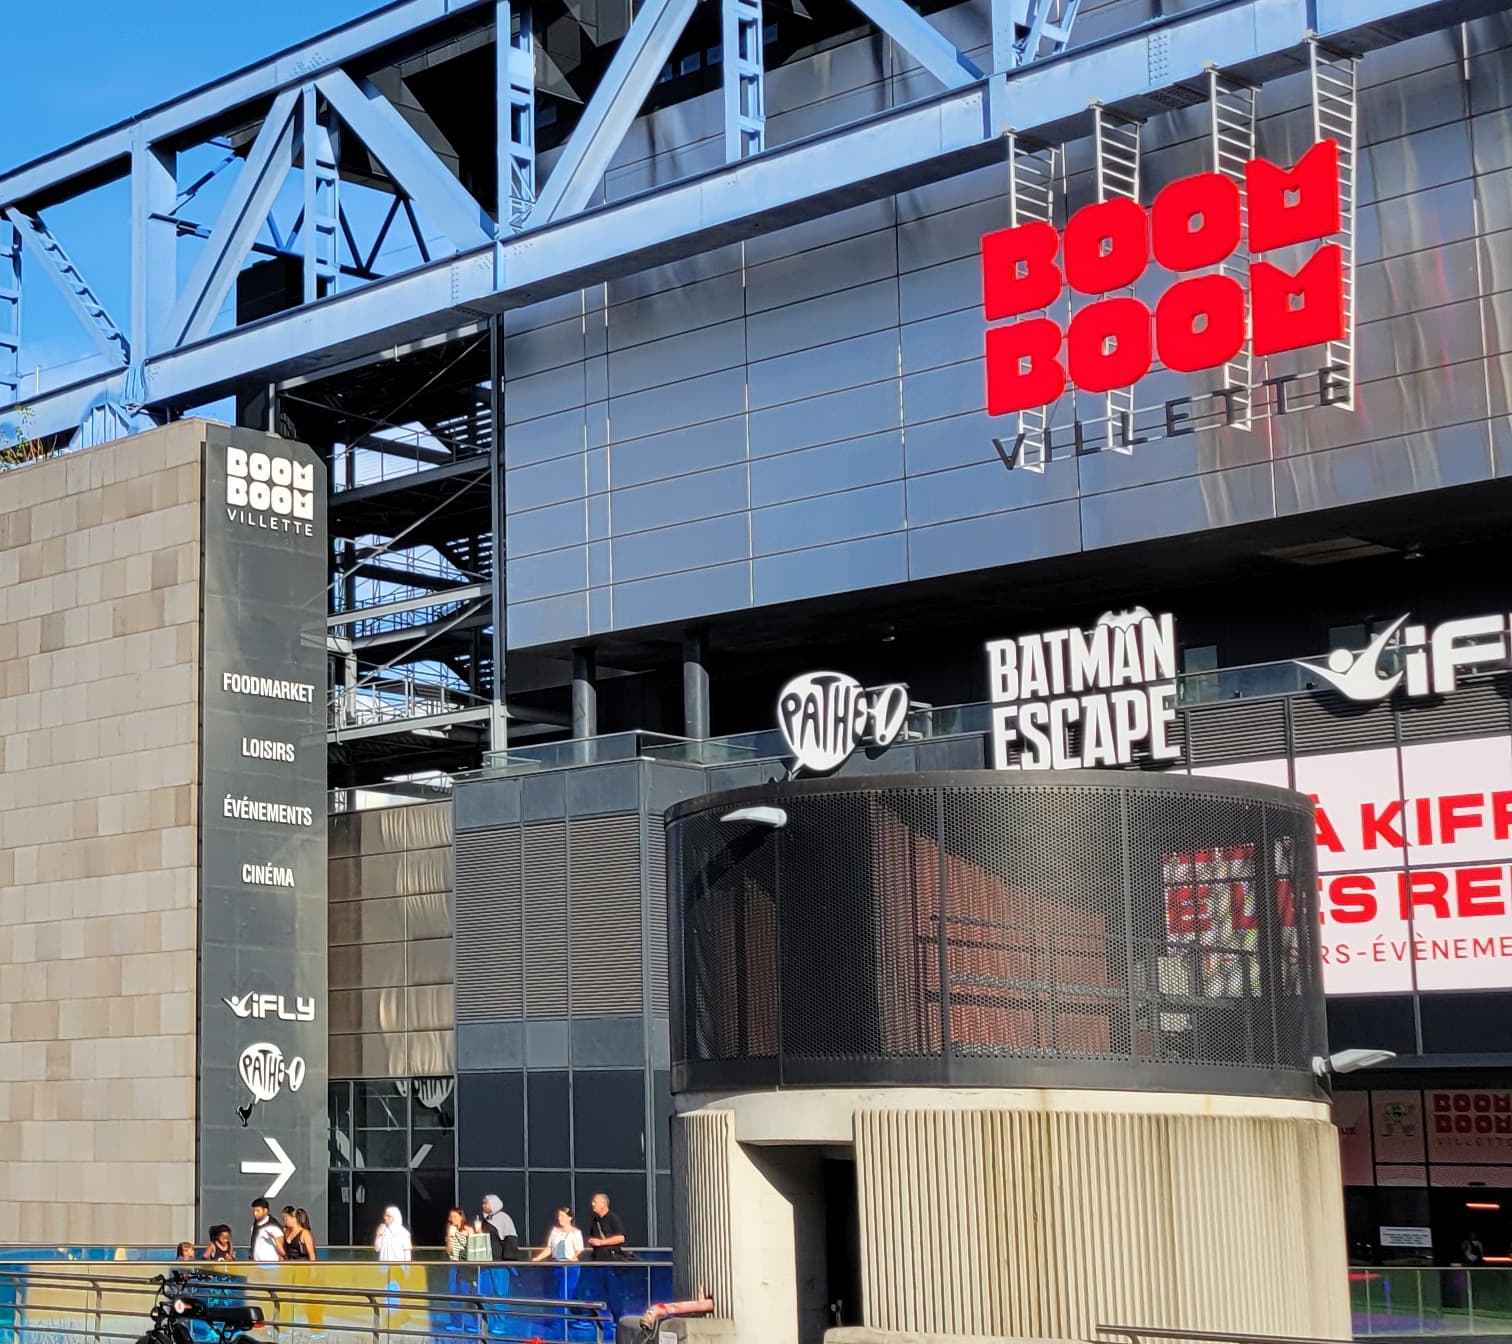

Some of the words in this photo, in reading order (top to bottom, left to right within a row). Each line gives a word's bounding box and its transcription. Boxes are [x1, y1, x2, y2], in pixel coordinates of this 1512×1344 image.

[981, 138, 1341, 321] BOOM
[985, 243, 1346, 417] BOOM
[991, 365, 1351, 471] VILLETTE
[226, 446, 314, 492] BOOM
[226, 475, 314, 521] BOOM
[226, 507, 314, 537] VILLETTE
[986, 612, 1178, 704] BATMAN
[1404, 613, 1512, 697] iF
[223, 672, 315, 703] FOODMARKET
[241, 736, 295, 763] LOISIRS
[991, 682, 1182, 771] ESCAPE
[223, 793, 313, 827] ÉVÉNEMENTS
[241, 861, 296, 888] CINÉMA
[1397, 865, 1512, 922] RE
[1433, 1093, 1512, 1114] BOOM
